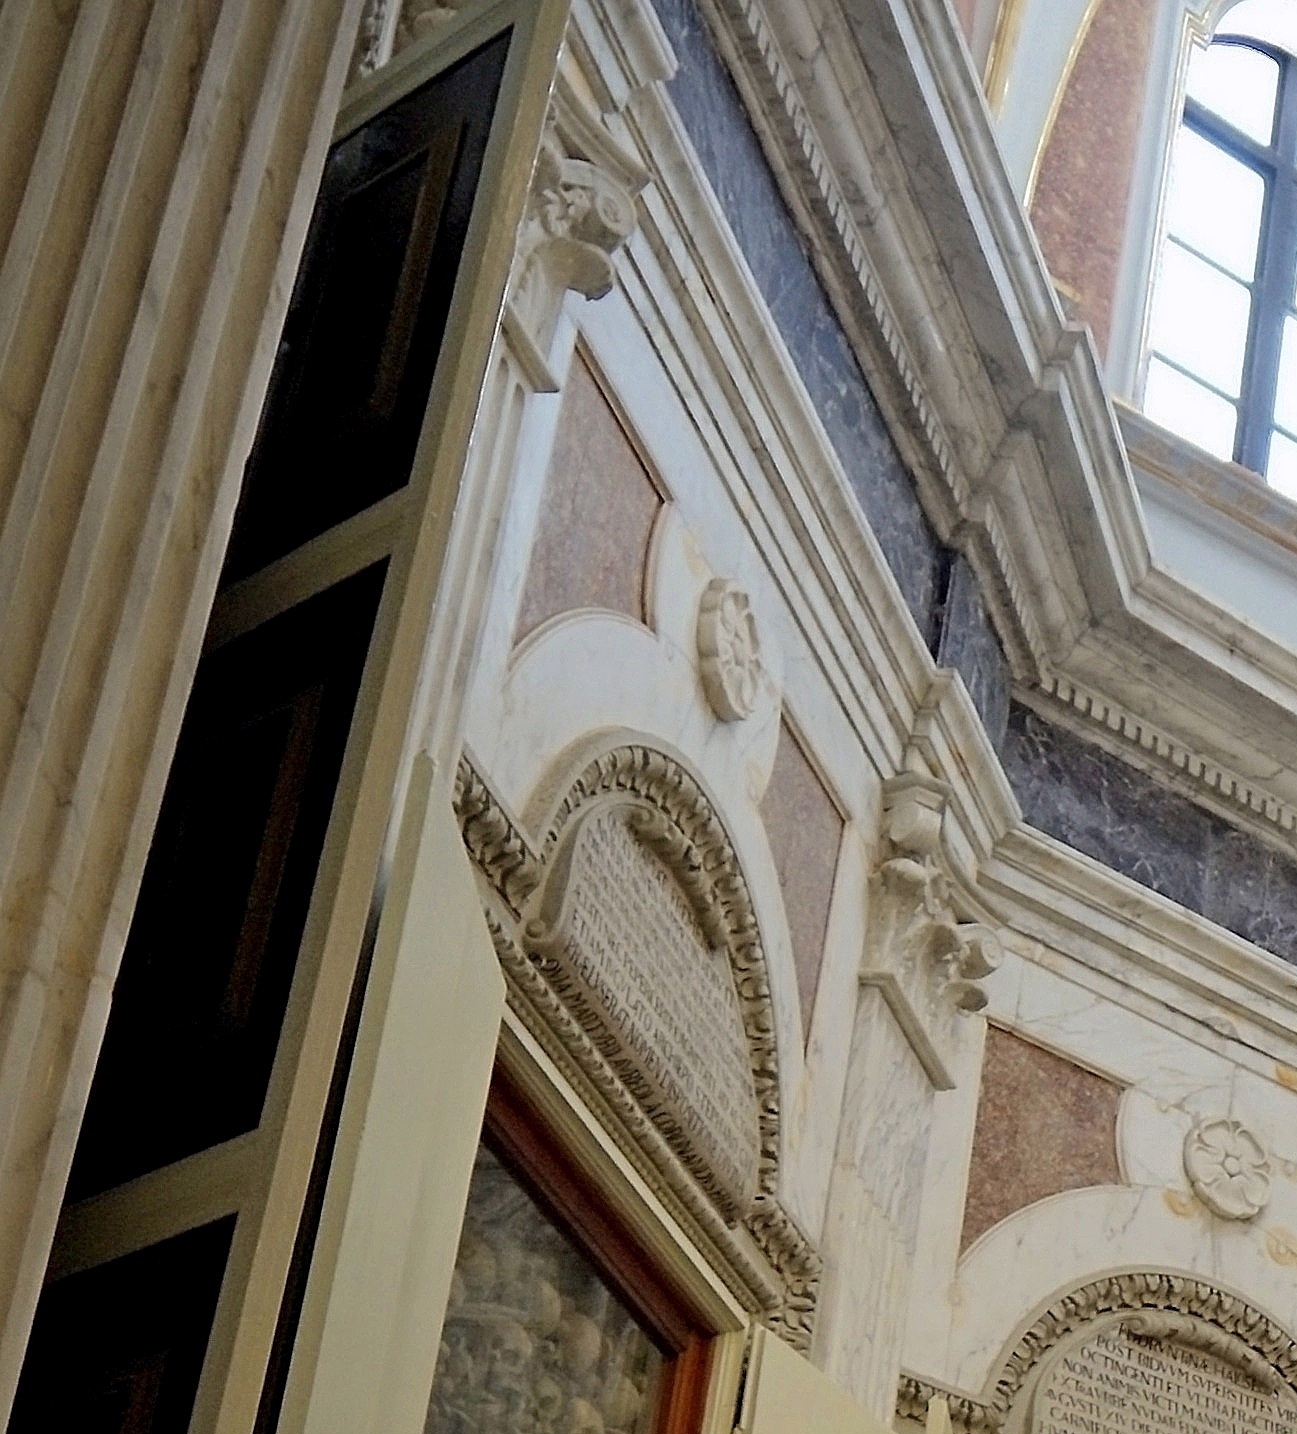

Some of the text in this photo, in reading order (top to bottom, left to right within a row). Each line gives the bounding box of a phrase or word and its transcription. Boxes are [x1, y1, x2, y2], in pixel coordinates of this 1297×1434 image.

[1096, 1334, 1131, 1360] POST
[1062, 1356, 1092, 1380] NON
[1142, 1388, 1177, 1413] VICTI
[1166, 1379, 1183, 1398] ET
